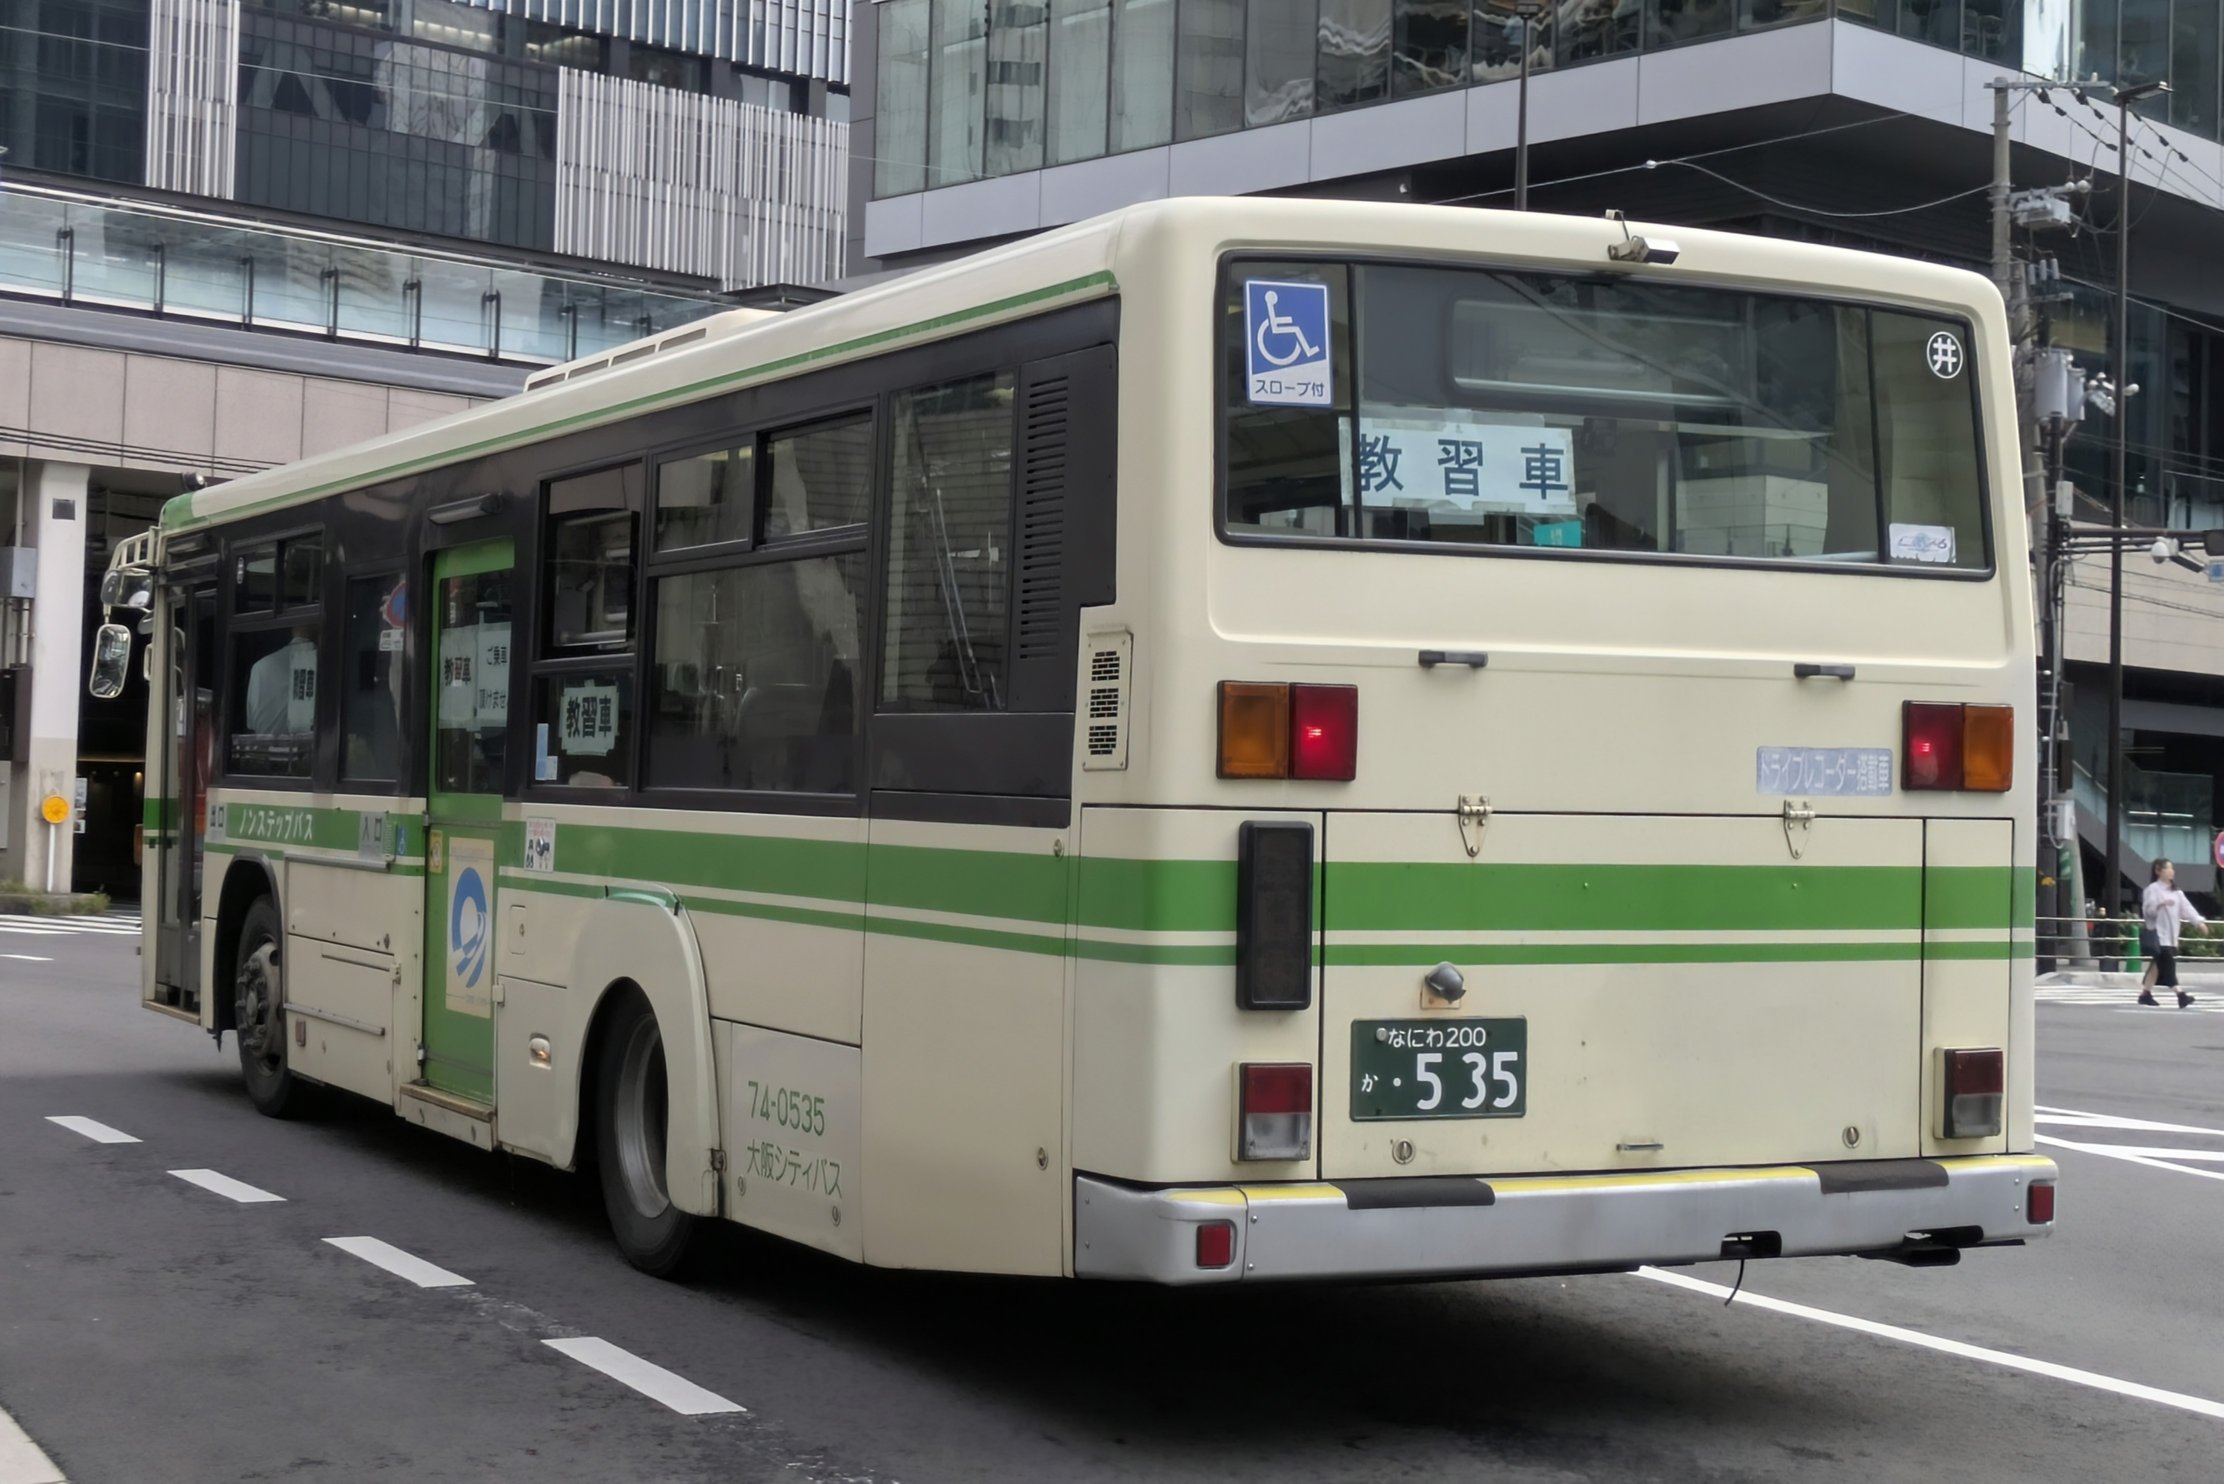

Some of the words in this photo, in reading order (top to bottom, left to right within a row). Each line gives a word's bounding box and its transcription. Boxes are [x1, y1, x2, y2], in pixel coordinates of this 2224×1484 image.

[1255, 379, 1325, 397] スロープ付
[1360, 433, 1569, 500] 教習車
[566, 694, 612, 739] 教習車
[239, 807, 314, 841] ノンステップバス
[361, 815, 382, 842] 入口
[748, 1080, 825, 1136] 74-0535
[747, 1138, 842, 1199] 大阪シティバス
